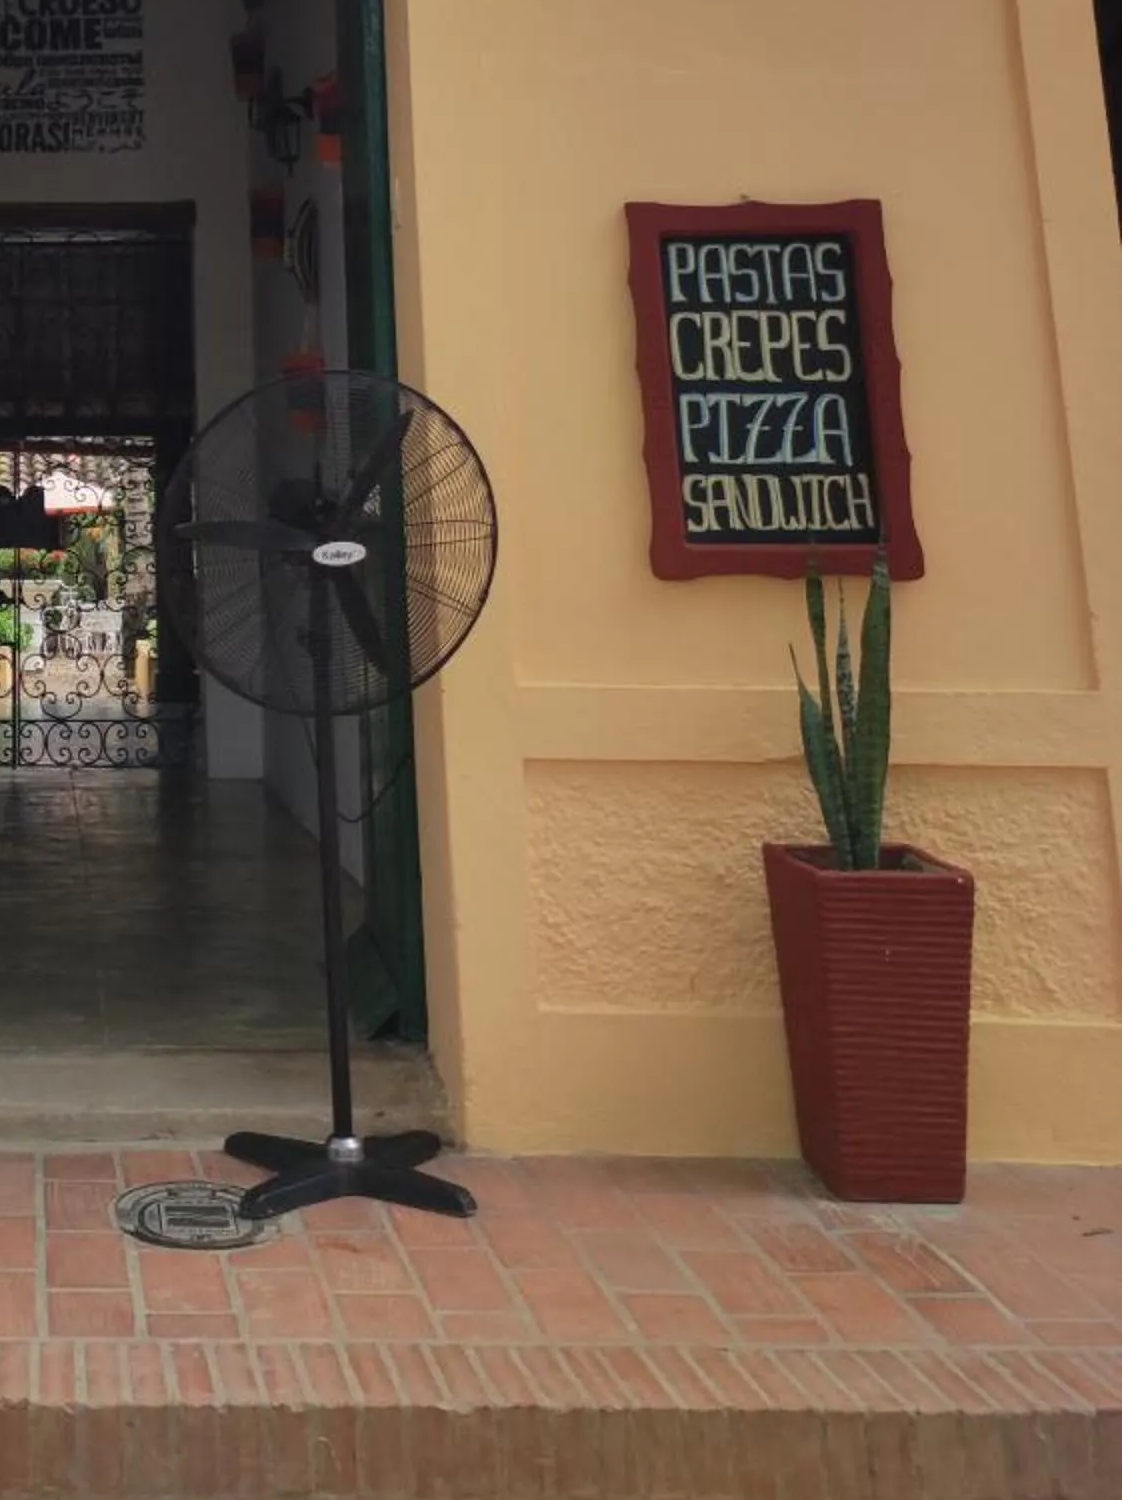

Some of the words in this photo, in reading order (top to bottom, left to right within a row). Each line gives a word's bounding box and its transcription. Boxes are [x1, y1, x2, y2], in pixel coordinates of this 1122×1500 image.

[666, 242, 847, 304] PASTAS
[669, 309, 853, 383] CREPES
[679, 392, 853, 467] PIZZA
[682, 473, 876, 533] SANDWICH
